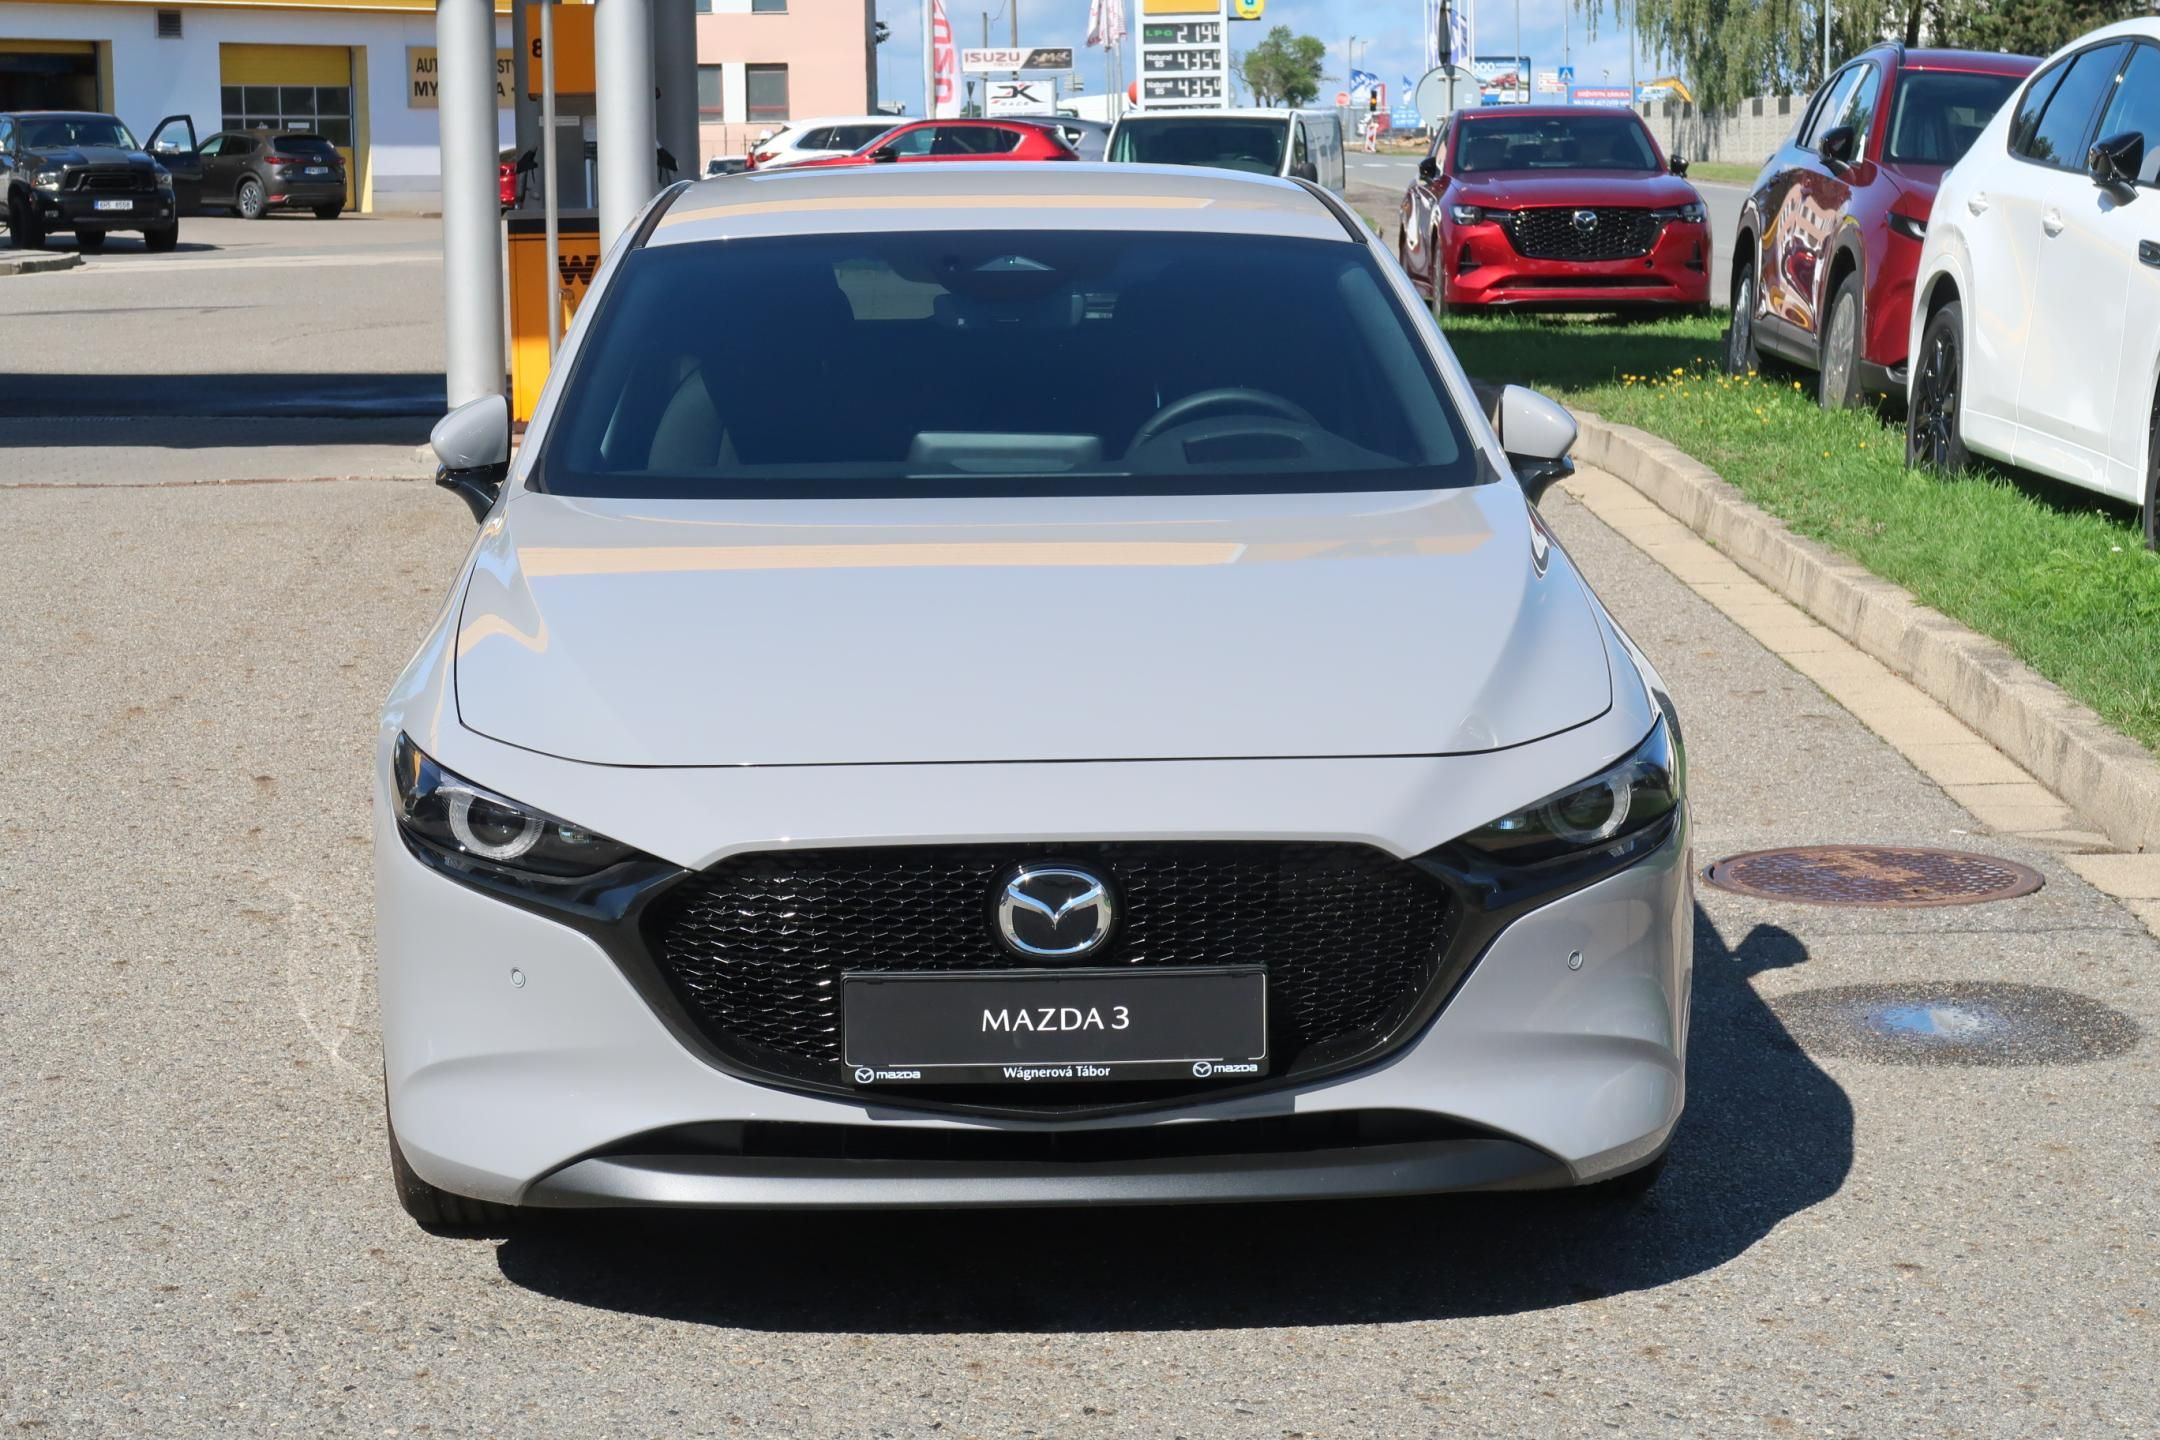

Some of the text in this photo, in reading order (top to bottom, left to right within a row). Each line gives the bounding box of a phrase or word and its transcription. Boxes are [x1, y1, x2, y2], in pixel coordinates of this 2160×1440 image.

[964, 51, 1020, 63] ISUZU
[981, 1006, 1130, 1033] MAZDA 3
[1003, 1064, 1111, 1081] Wágnerová Tábor
[1213, 1063, 1258, 1073] mazda
[876, 1070, 921, 1080] mazda
